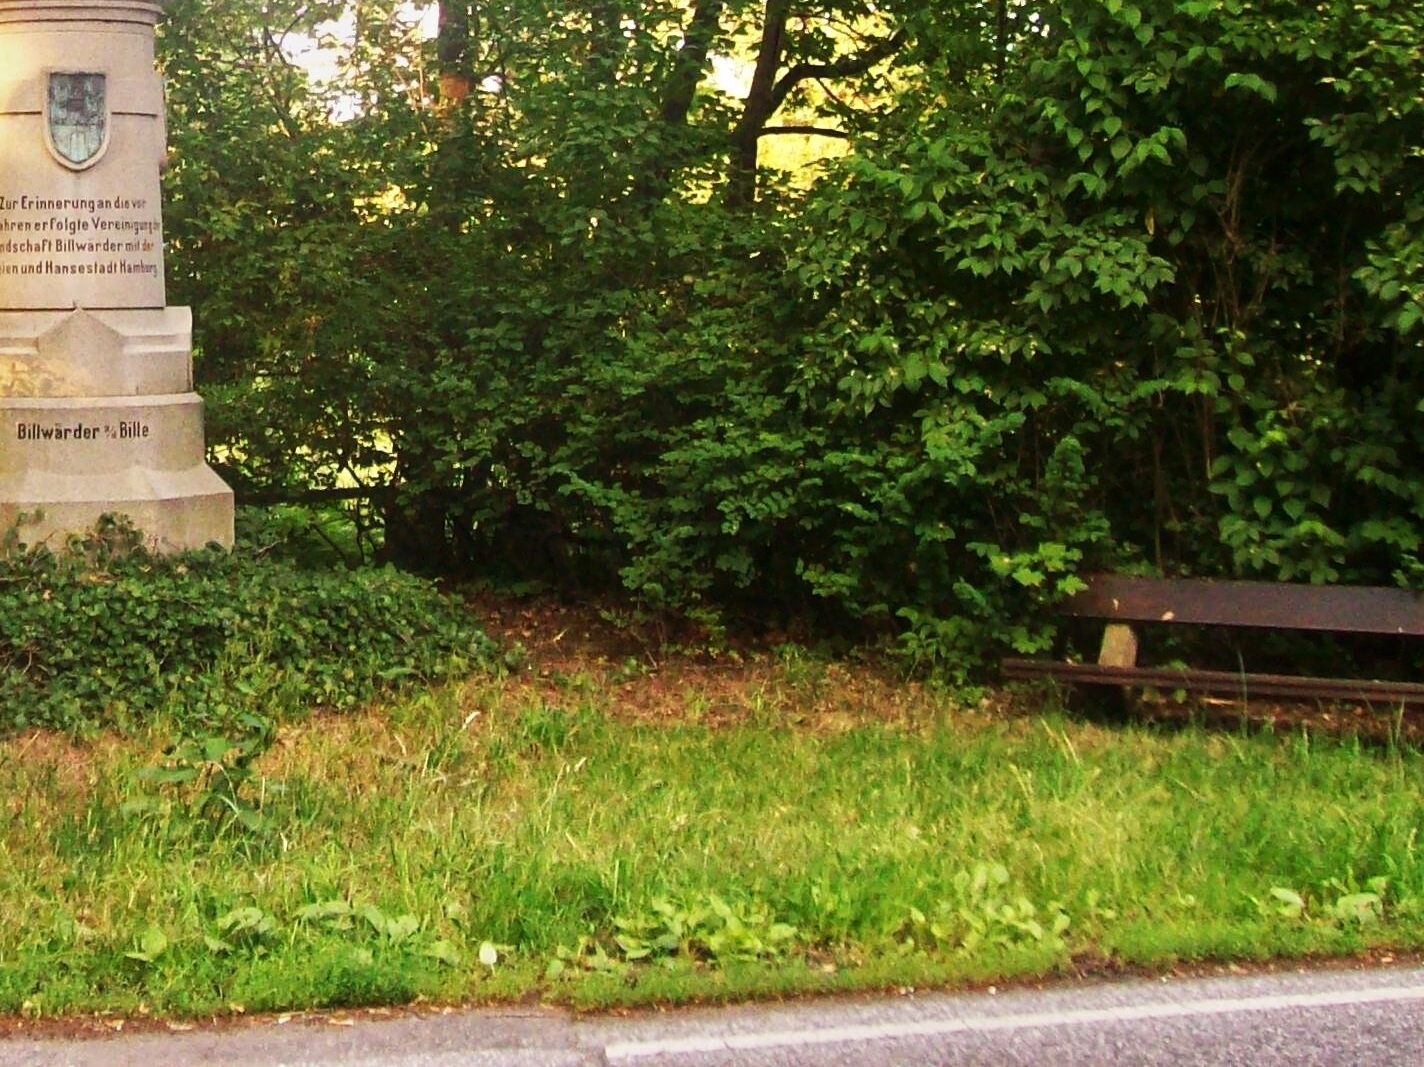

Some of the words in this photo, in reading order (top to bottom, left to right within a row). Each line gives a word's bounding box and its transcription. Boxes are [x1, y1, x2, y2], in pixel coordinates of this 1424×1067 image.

[0, 196, 18, 210] Zur
[21, 195, 95, 213] Erinnerung
[97, 200, 111, 209] an
[114, 196, 130, 209] die
[34, 217, 89, 235] erfolgte
[55, 238, 123, 252] Billwärder
[125, 240, 140, 252] mit
[21, 261, 42, 274] und
[45, 260, 117, 274] Hansestadt
[120, 260, 158, 277] Hamburg
[17, 422, 100, 440] Billwärder
[119, 421, 150, 438] Bille
